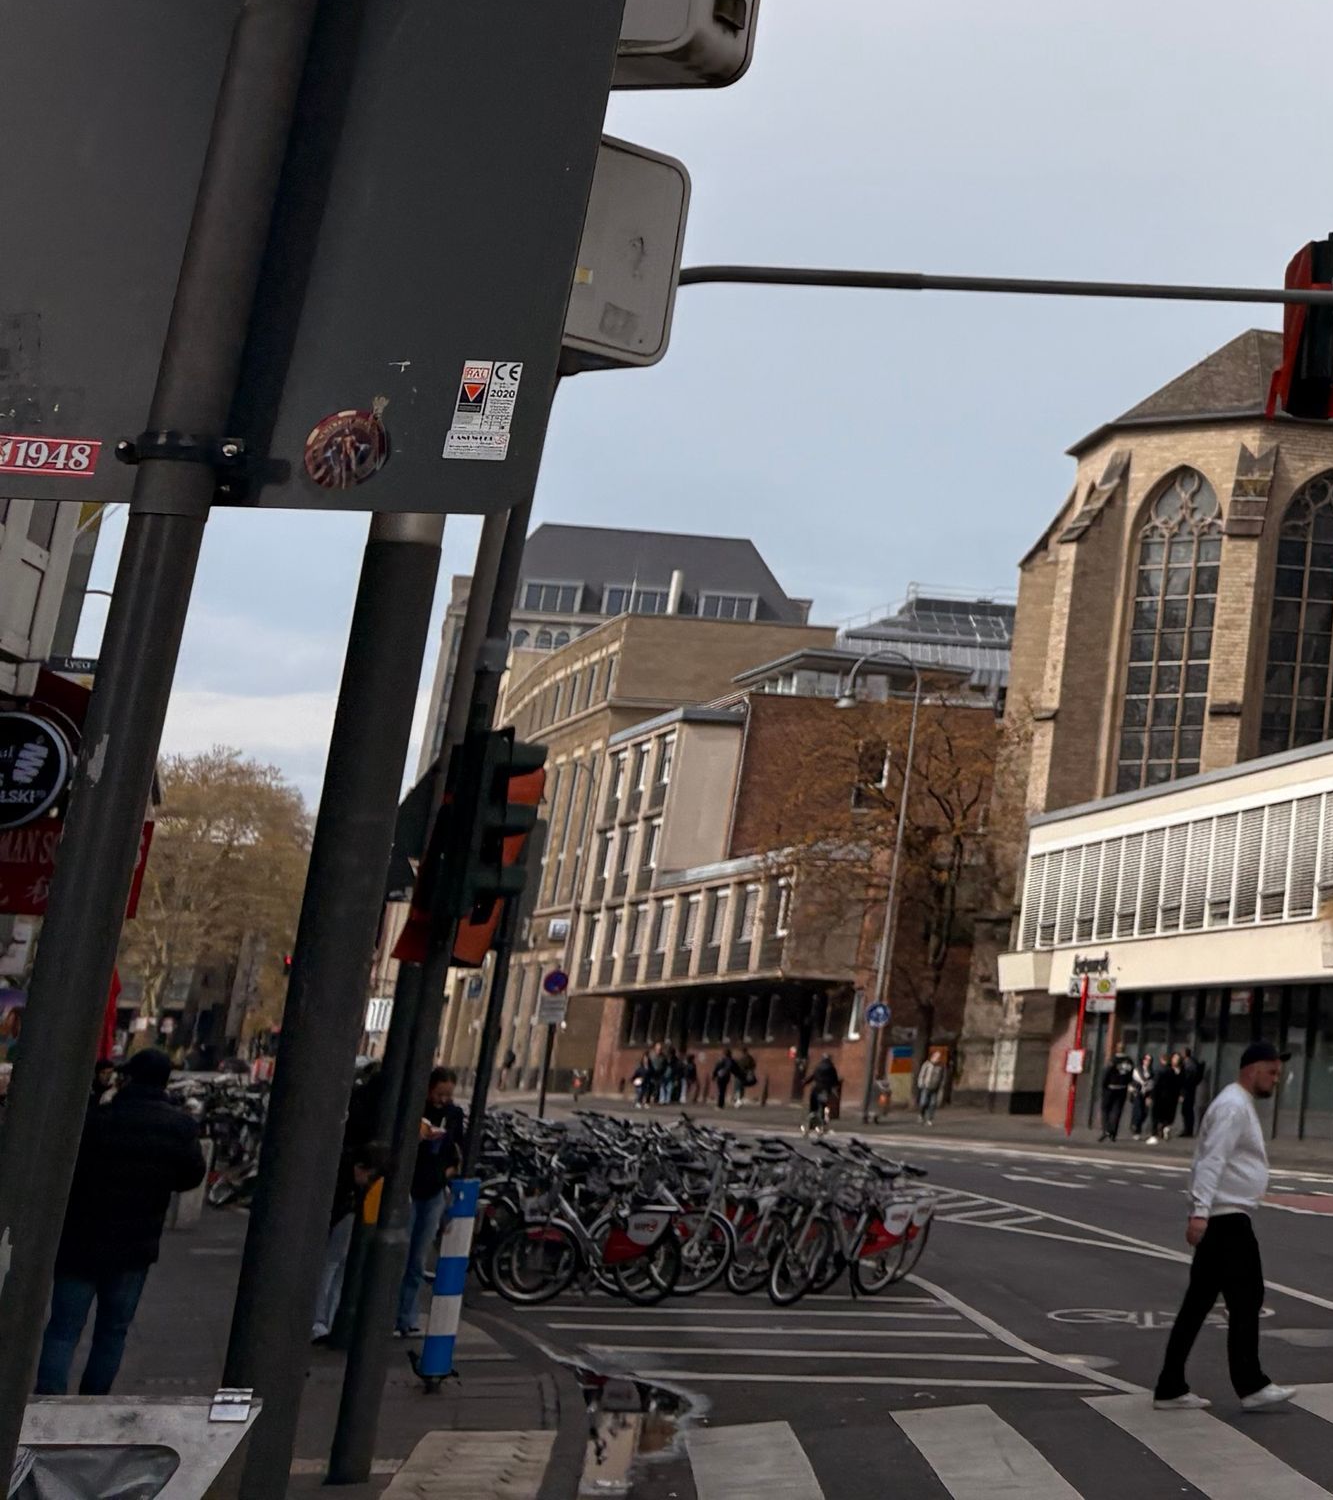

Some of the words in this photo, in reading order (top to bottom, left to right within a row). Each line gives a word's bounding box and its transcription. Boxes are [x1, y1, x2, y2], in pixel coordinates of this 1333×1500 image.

[495, 363, 521, 381] CE
[490, 389, 515, 398] 2020
[14, 441, 92, 471] 1948
